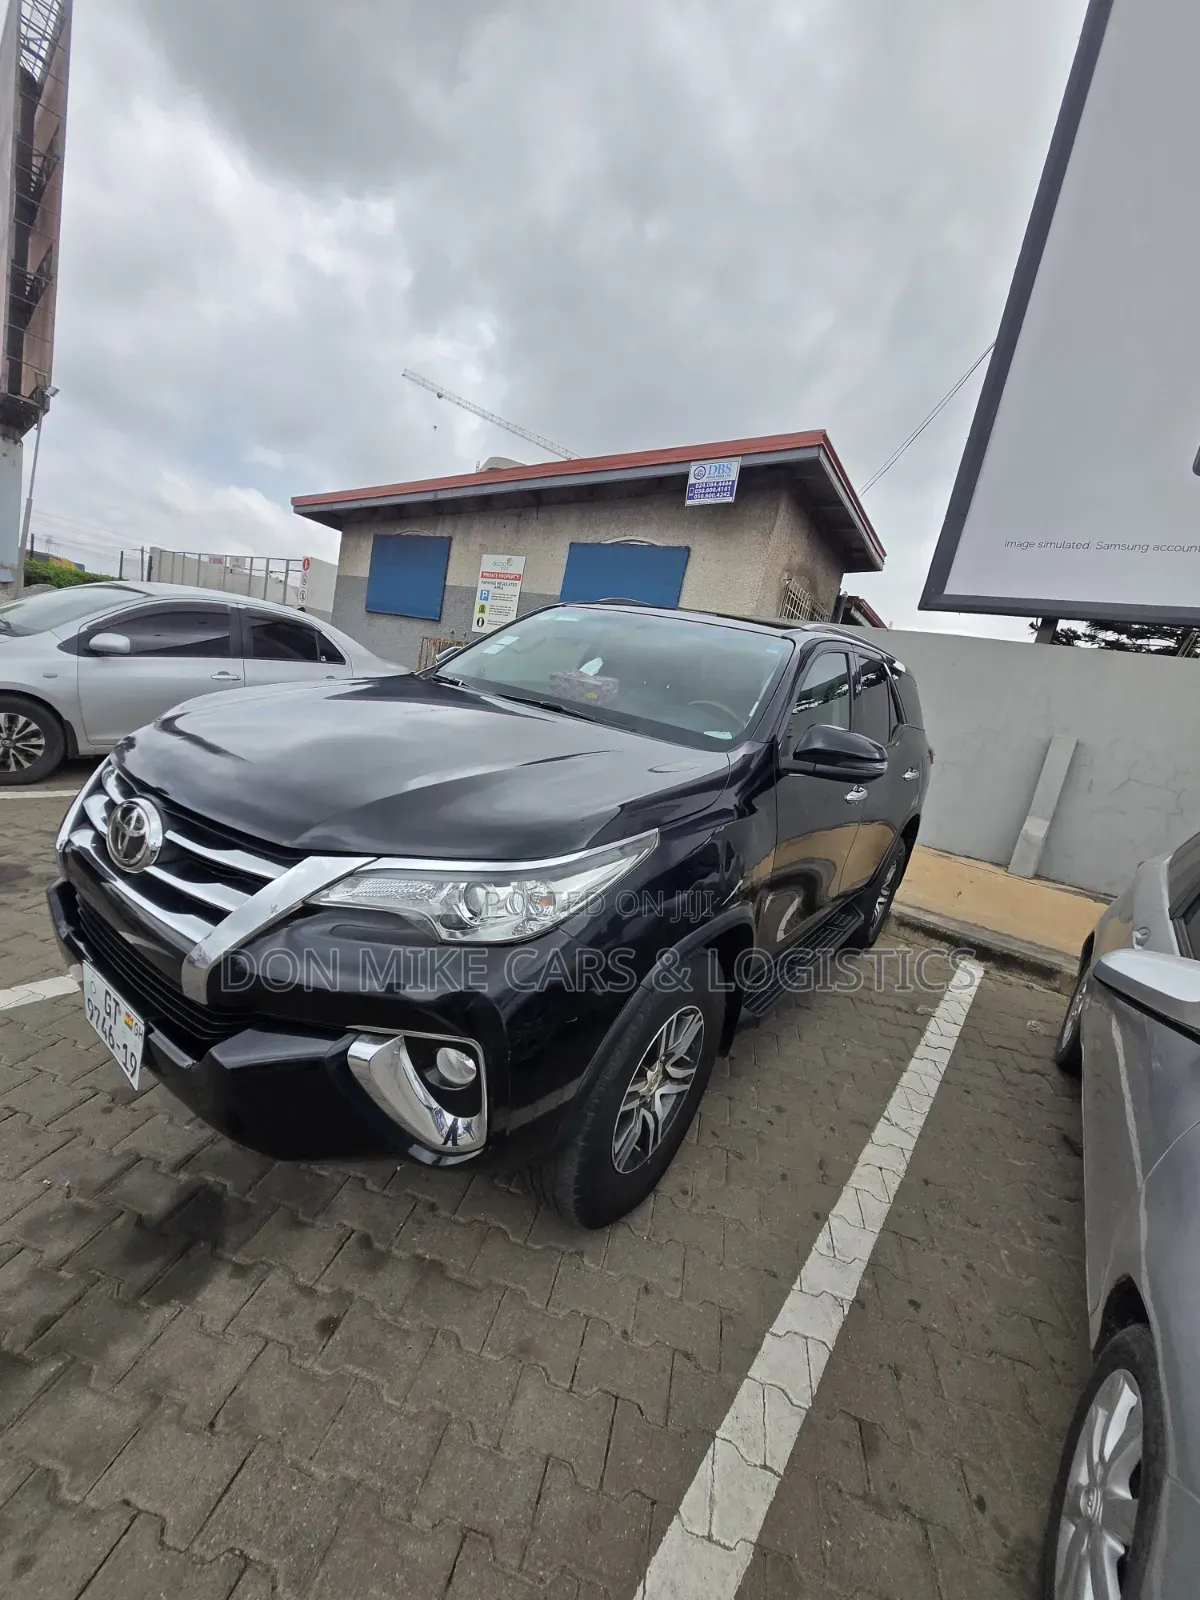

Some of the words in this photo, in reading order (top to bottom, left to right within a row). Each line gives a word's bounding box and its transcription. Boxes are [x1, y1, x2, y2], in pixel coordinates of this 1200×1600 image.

[707, 463, 732, 475] DBS
[1004, 539, 1036, 550] Image
[1037, 540, 1092, 551] simulated.
[1095, 541, 1150, 553] Samsung
[481, 590, 488, 600] P
[104, 989, 120, 1026] GT
[87, 997, 138, 1079] 9746-19
[133, 1022, 143, 1041] GH
